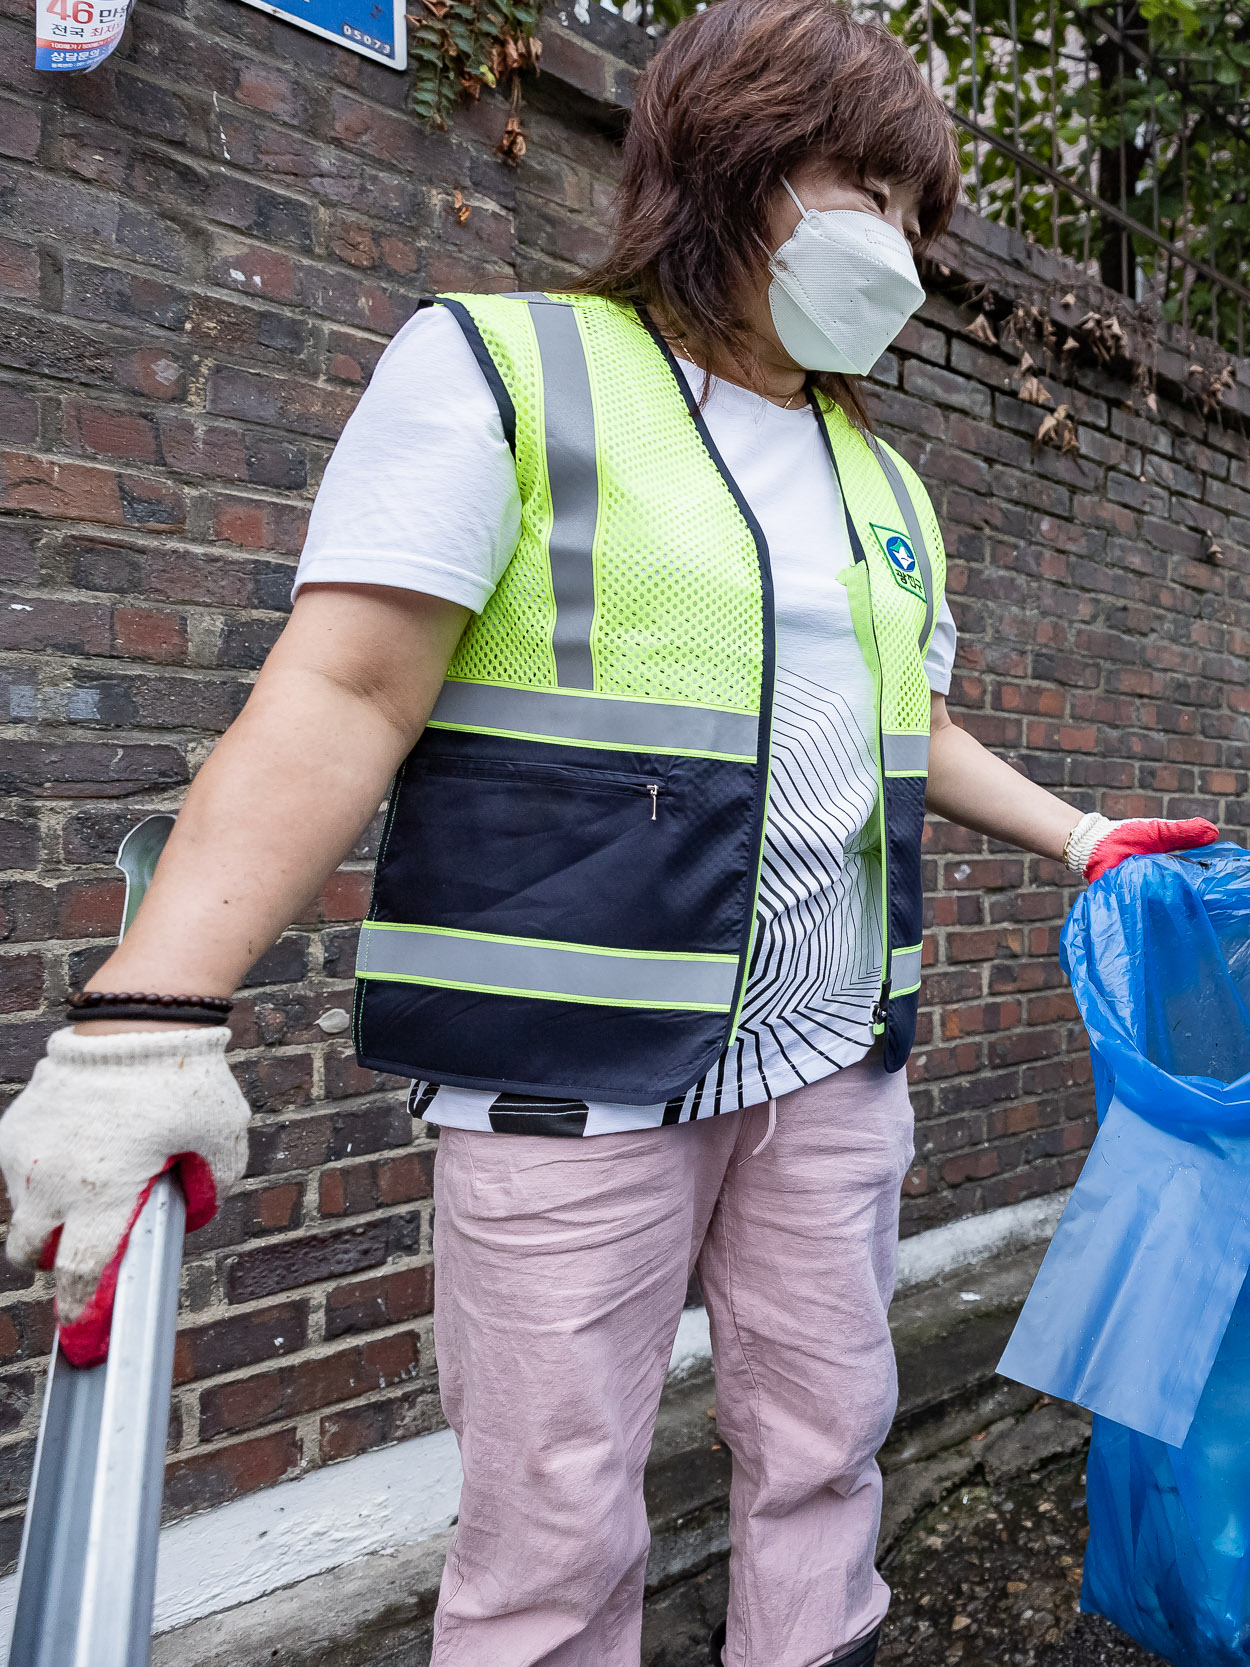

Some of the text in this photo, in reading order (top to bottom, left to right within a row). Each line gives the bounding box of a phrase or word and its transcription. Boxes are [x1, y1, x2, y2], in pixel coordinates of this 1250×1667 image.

[46, 0, 95, 24] 46
[51, 23, 85, 38] 전국
[343, 25, 391, 54] 05073
[50, 49, 100, 62] 상담문의
[894, 568, 923, 594] 광진구
